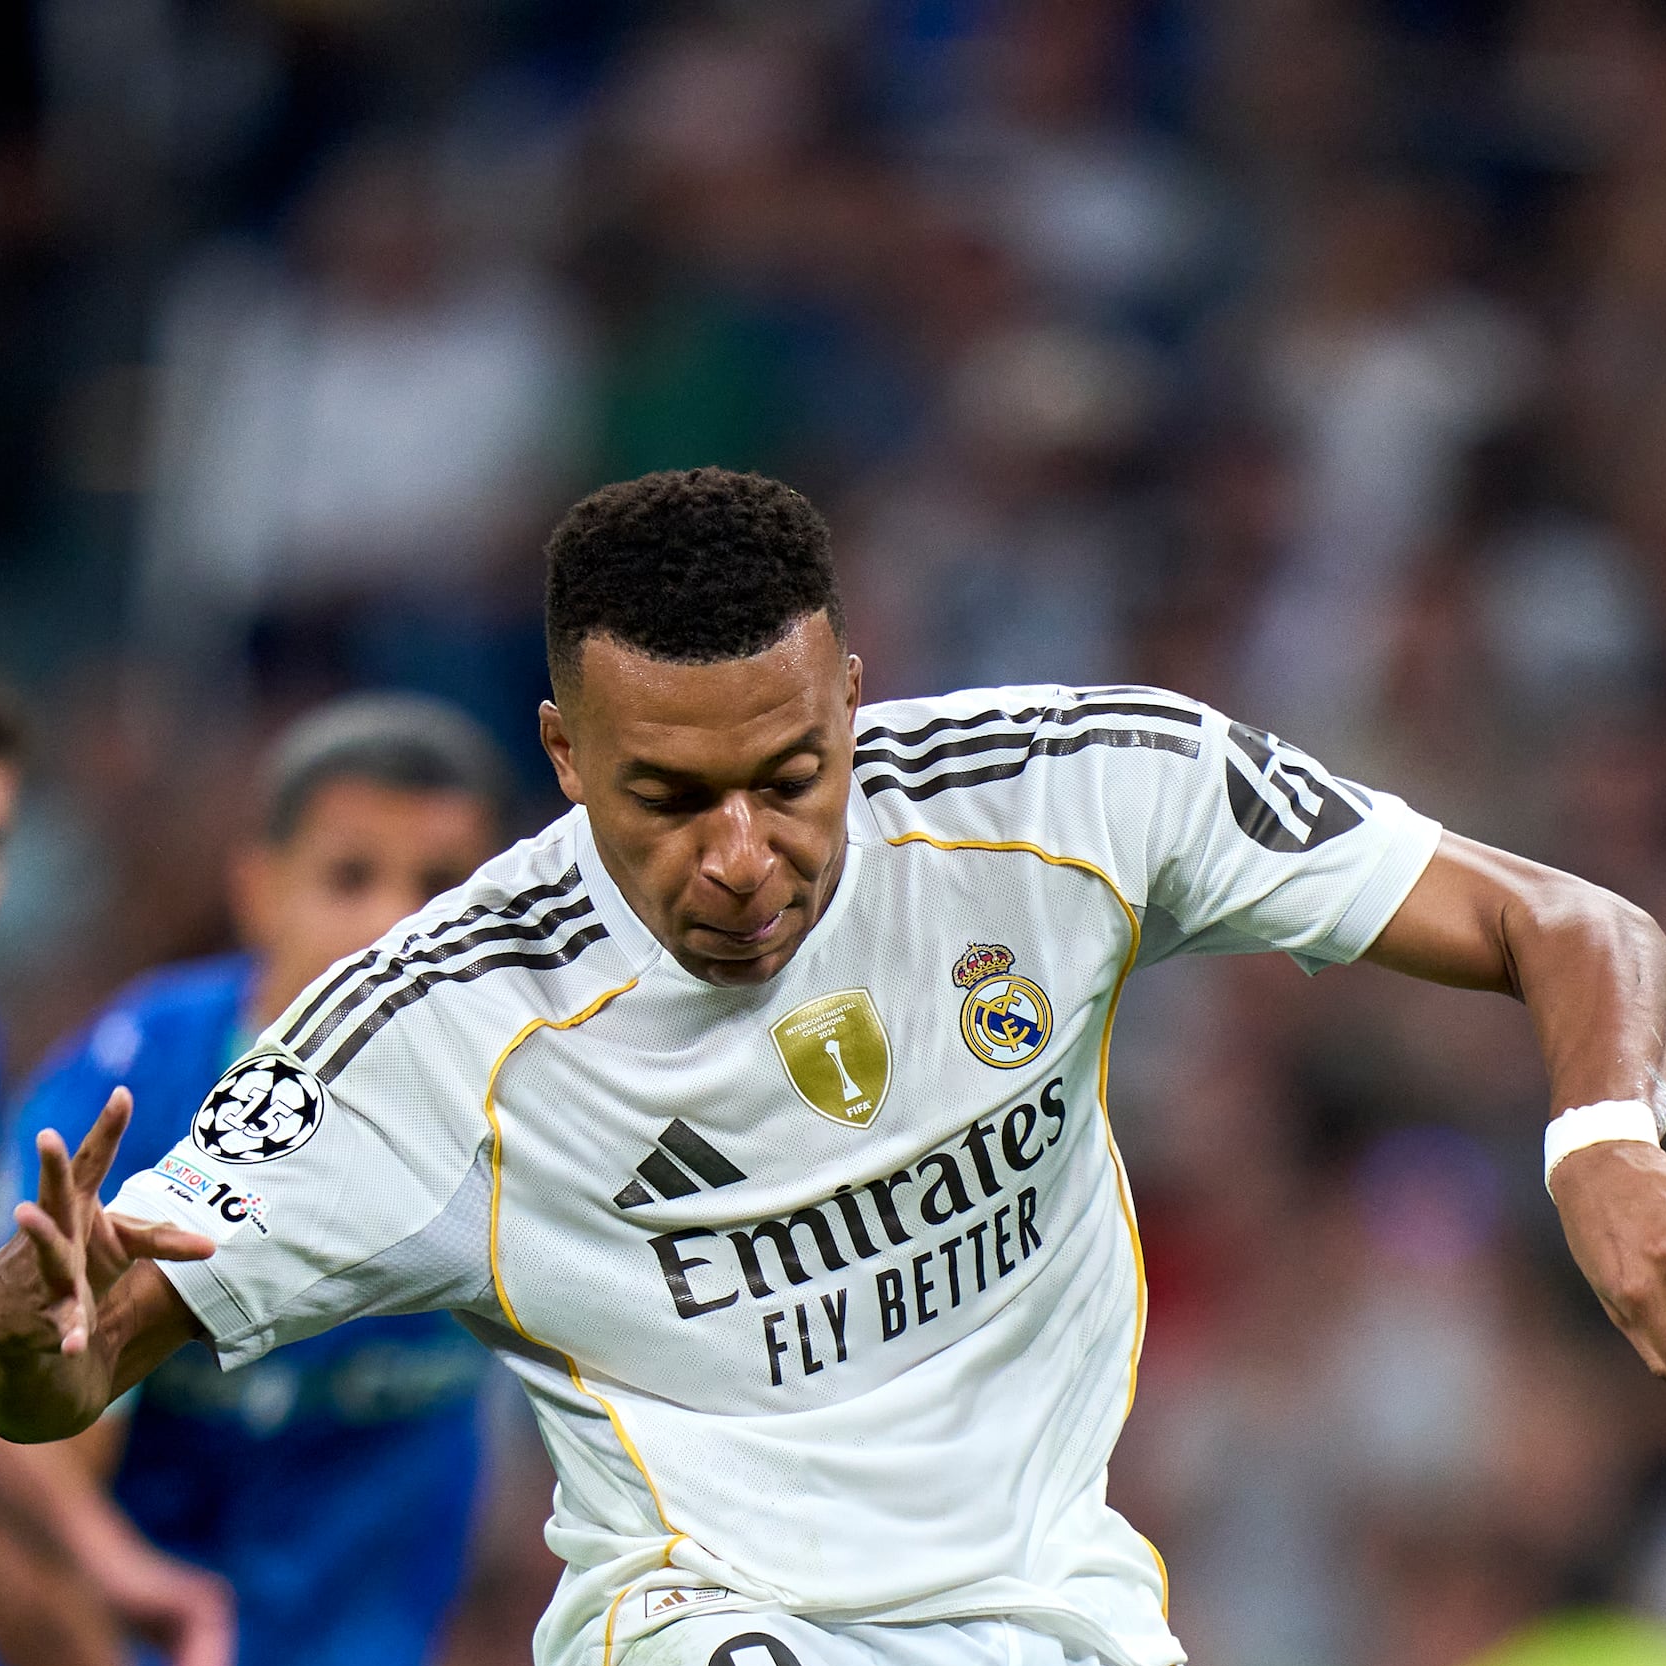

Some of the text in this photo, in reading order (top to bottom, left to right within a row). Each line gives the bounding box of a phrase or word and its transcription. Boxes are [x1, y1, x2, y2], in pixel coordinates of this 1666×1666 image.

[785, 1002, 856, 1036] INTERCONTINENTAL
[802, 1014, 846, 1037] CHAMPIONS
[817, 1028, 836, 1038] 2024
[223, 1087, 294, 1138] 15
[846, 1101, 871, 1117] FIFA
[647, 1076, 1067, 1320] Emirates
[250, 1213, 267, 1233] YEARS
[761, 1185, 1043, 1387] FLY BETTER
